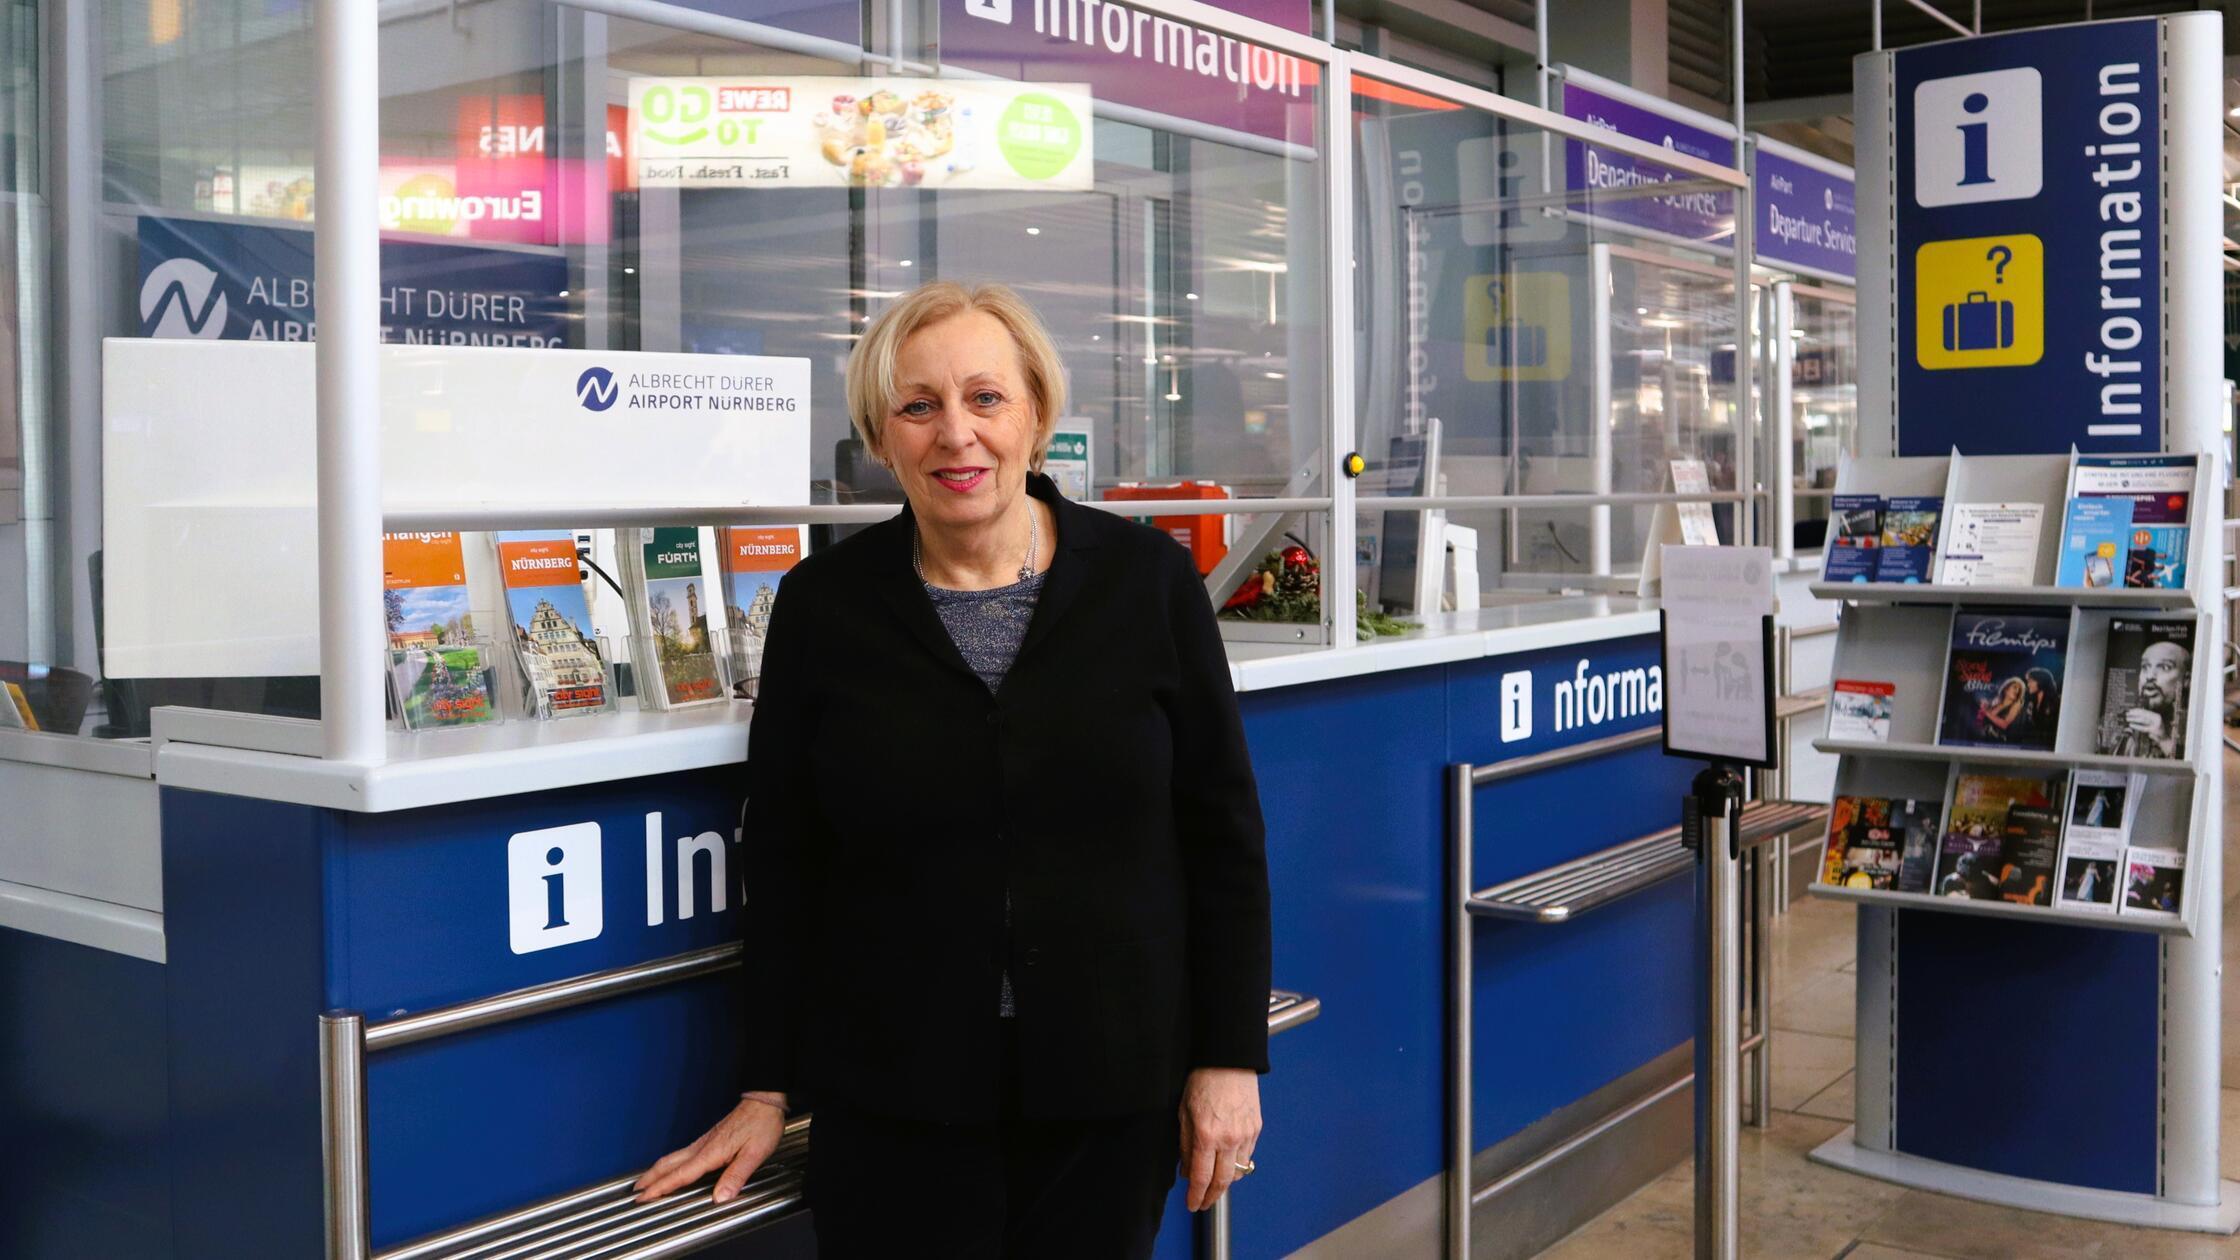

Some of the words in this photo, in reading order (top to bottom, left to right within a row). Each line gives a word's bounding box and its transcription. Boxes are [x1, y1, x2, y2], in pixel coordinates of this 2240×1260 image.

[1770, 203, 1822, 247] Departure
[2085, 62, 2142, 437] Information
[427, 288, 526, 324] DÜRER
[628, 373, 715, 390] ALBRECHT
[720, 375, 774, 392] DÜRER
[628, 394, 703, 410] AIRPORT
[708, 395, 796, 412] NÜRNBERG
[657, 551, 698, 565] FÜRTH
[739, 544, 795, 556] NÜRNBERG
[511, 556, 573, 572] NÜRNBERG
[1554, 659, 1663, 733] nforma
[646, 797, 748, 927] In
